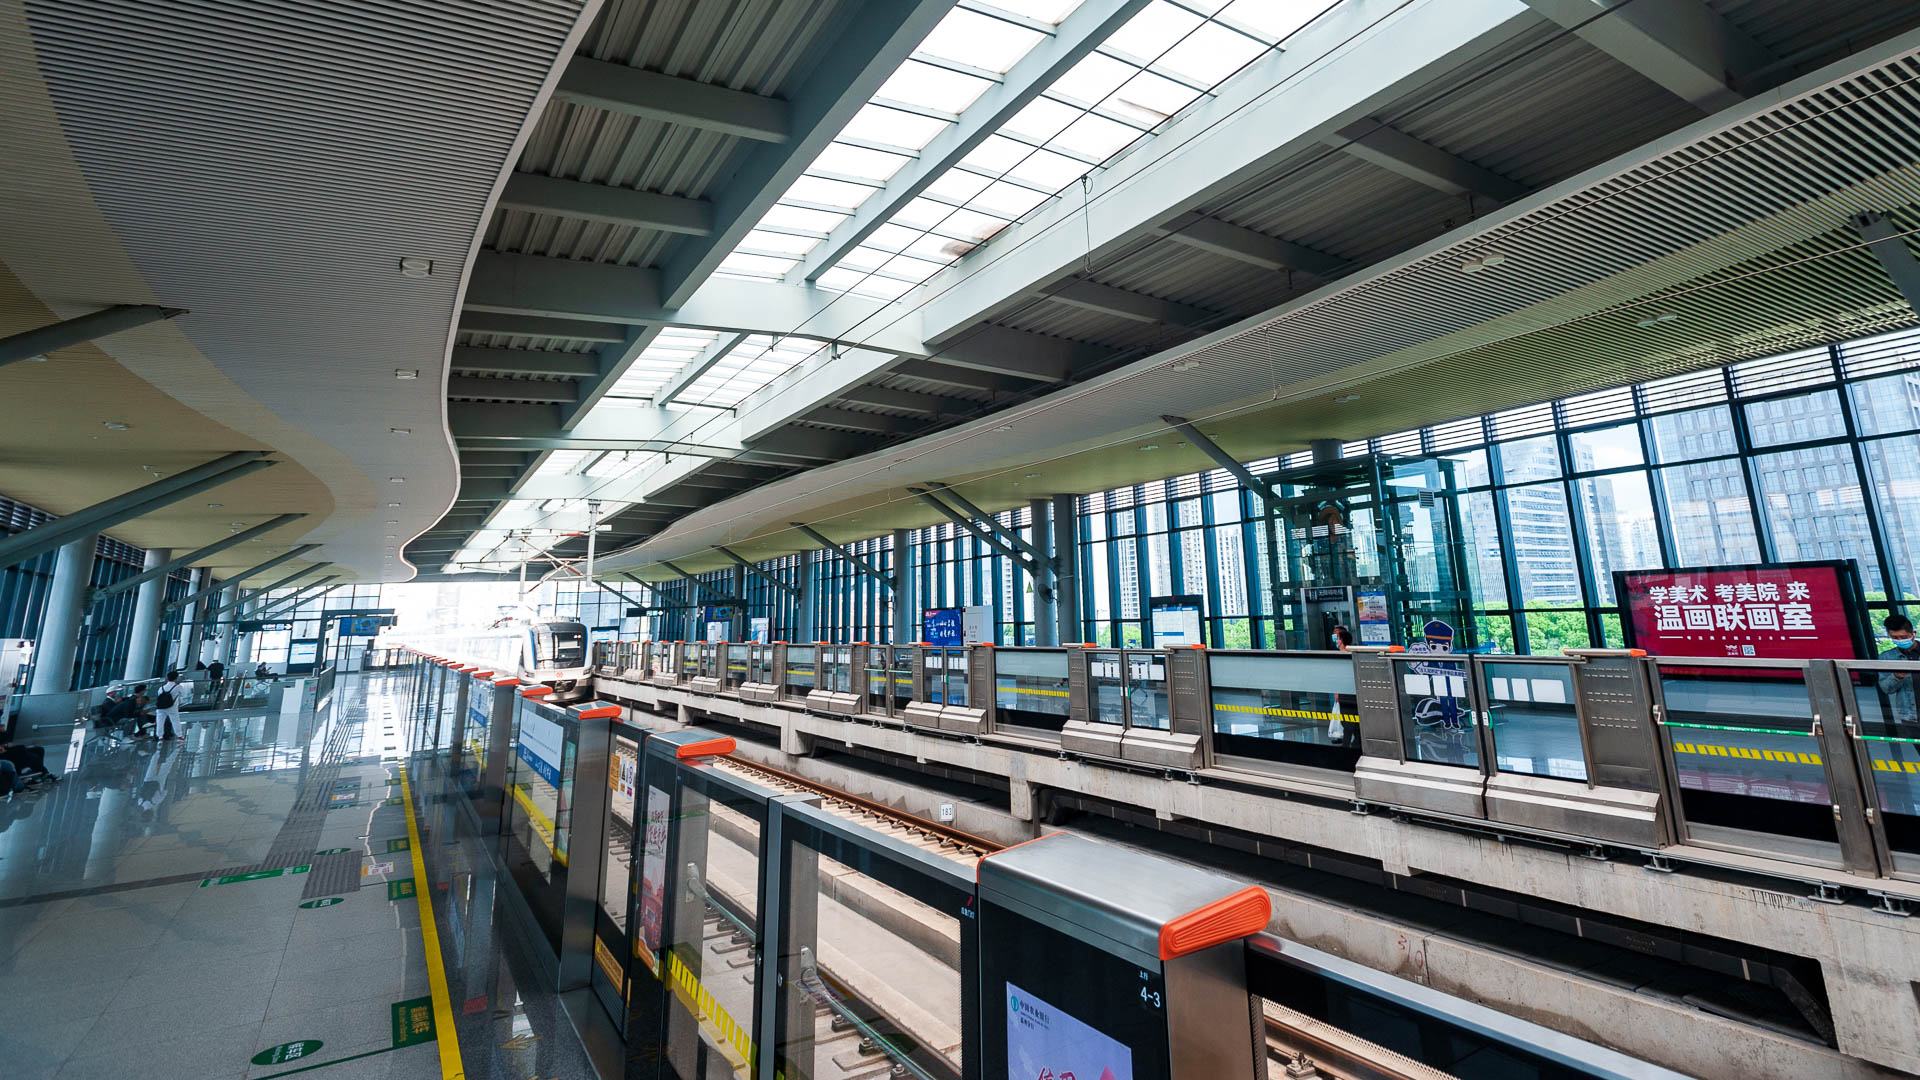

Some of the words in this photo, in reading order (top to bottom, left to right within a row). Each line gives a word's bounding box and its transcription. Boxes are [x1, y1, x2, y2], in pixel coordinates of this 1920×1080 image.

[1649, 584, 1709, 604] 学美术
[1714, 582, 1780, 602] 考美院
[1787, 580, 1811, 601] 来
[1655, 602, 1816, 631] 温画联画室
[942, 807, 952, 816] 183
[1140, 986, 1161, 1008] 4-3
